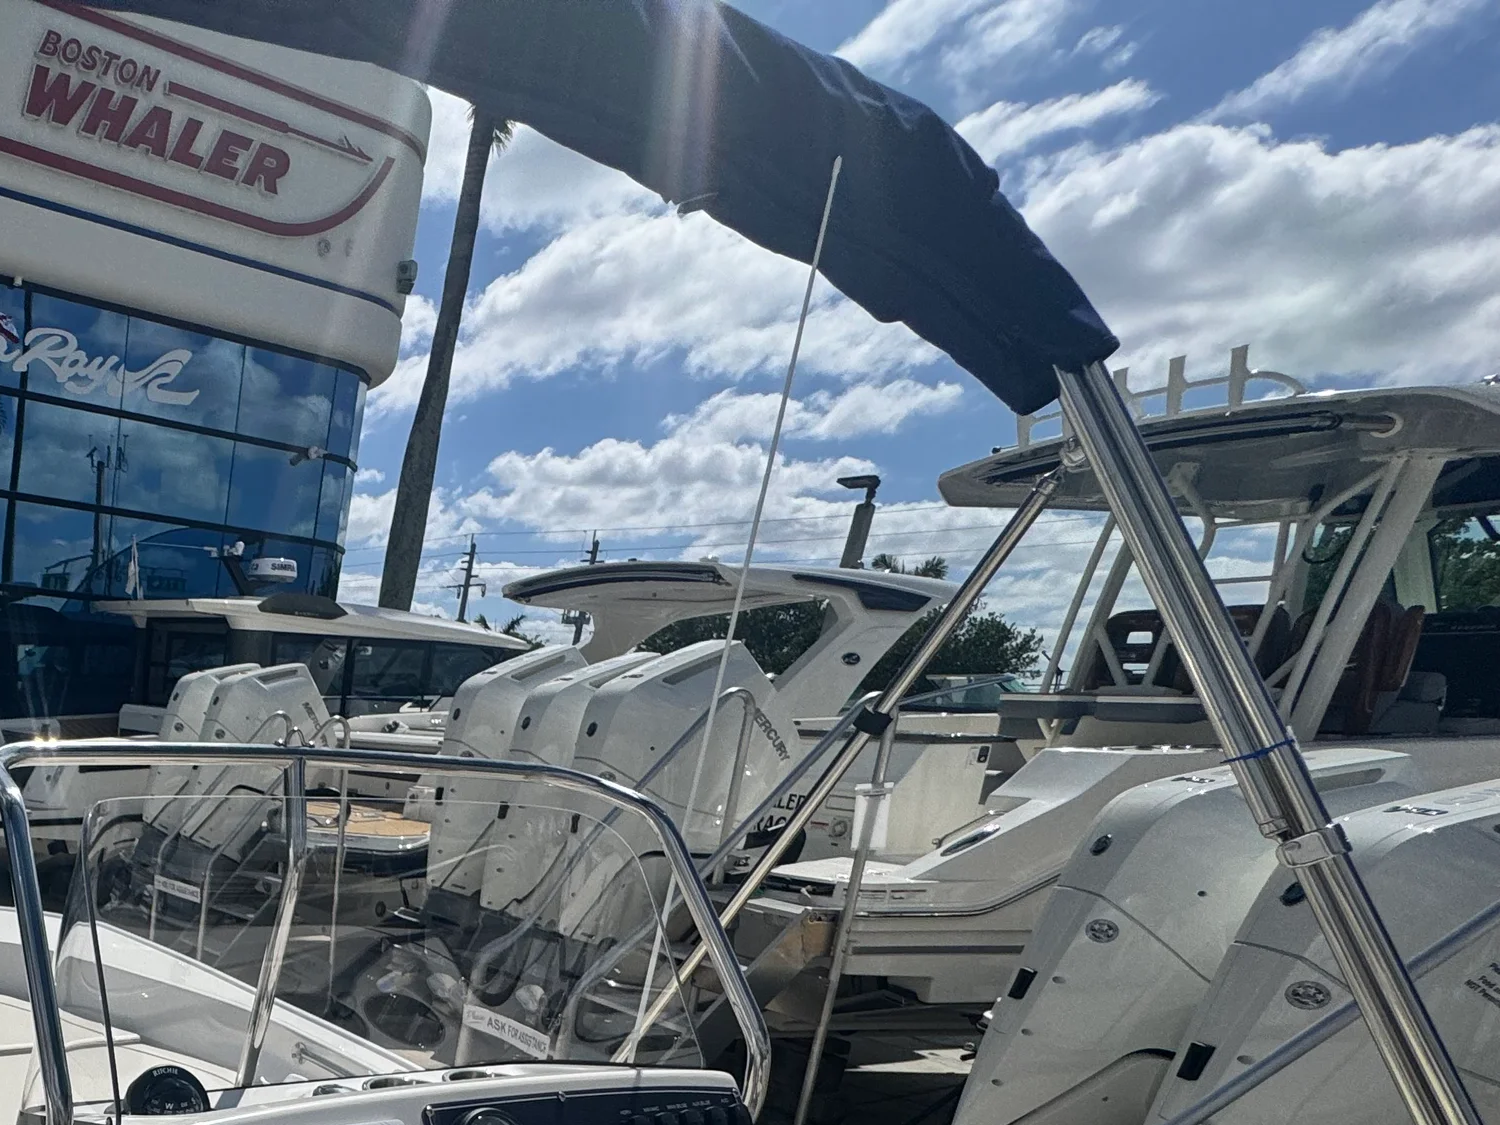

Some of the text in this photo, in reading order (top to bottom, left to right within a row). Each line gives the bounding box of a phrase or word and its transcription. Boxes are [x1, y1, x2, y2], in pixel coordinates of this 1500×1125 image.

[36, 29, 161, 93] BOSTON
[23, 63, 291, 196] WHALER
[12, 327, 120, 395] Ray
[487, 1017, 507, 1035] ASK
[507, 1024, 519, 1041] FOR
